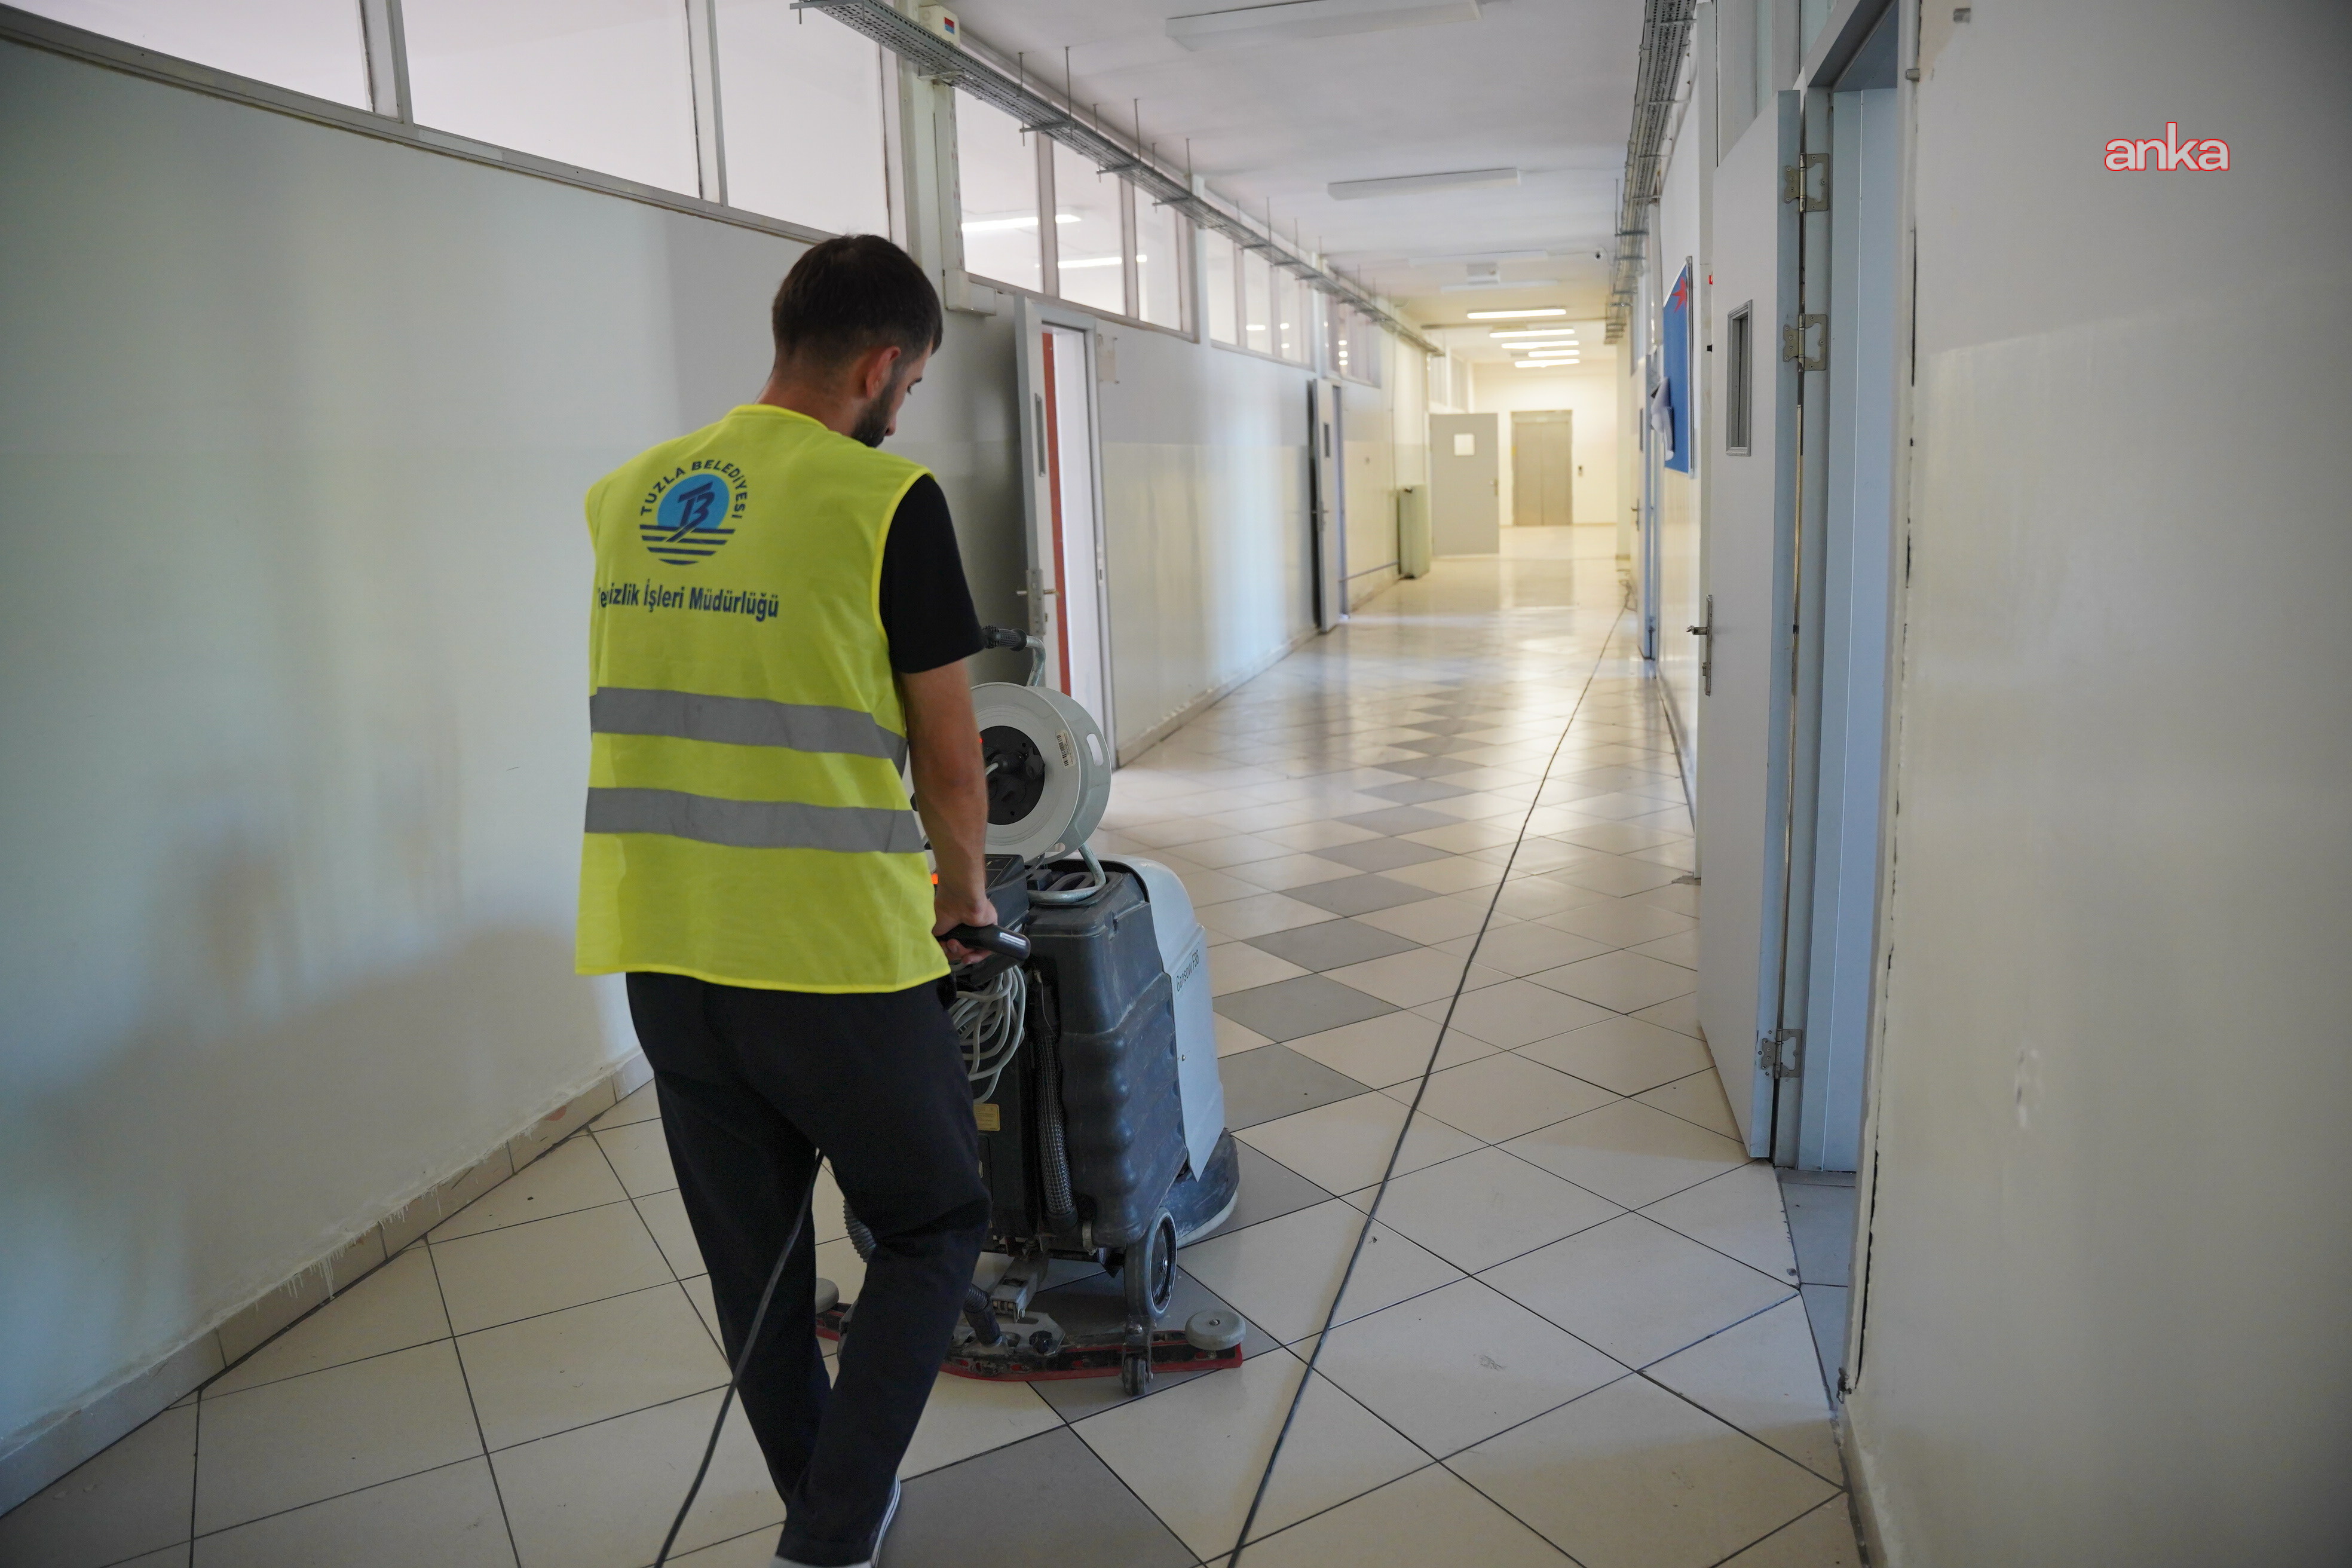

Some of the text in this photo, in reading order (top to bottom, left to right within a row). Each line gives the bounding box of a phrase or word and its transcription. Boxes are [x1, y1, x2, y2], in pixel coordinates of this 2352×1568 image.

[641, 467, 685, 516] TUZLA
[598, 578, 779, 622] eizlik İşleri Müdürlüğü
[1176, 961, 1192, 992] Gansow
